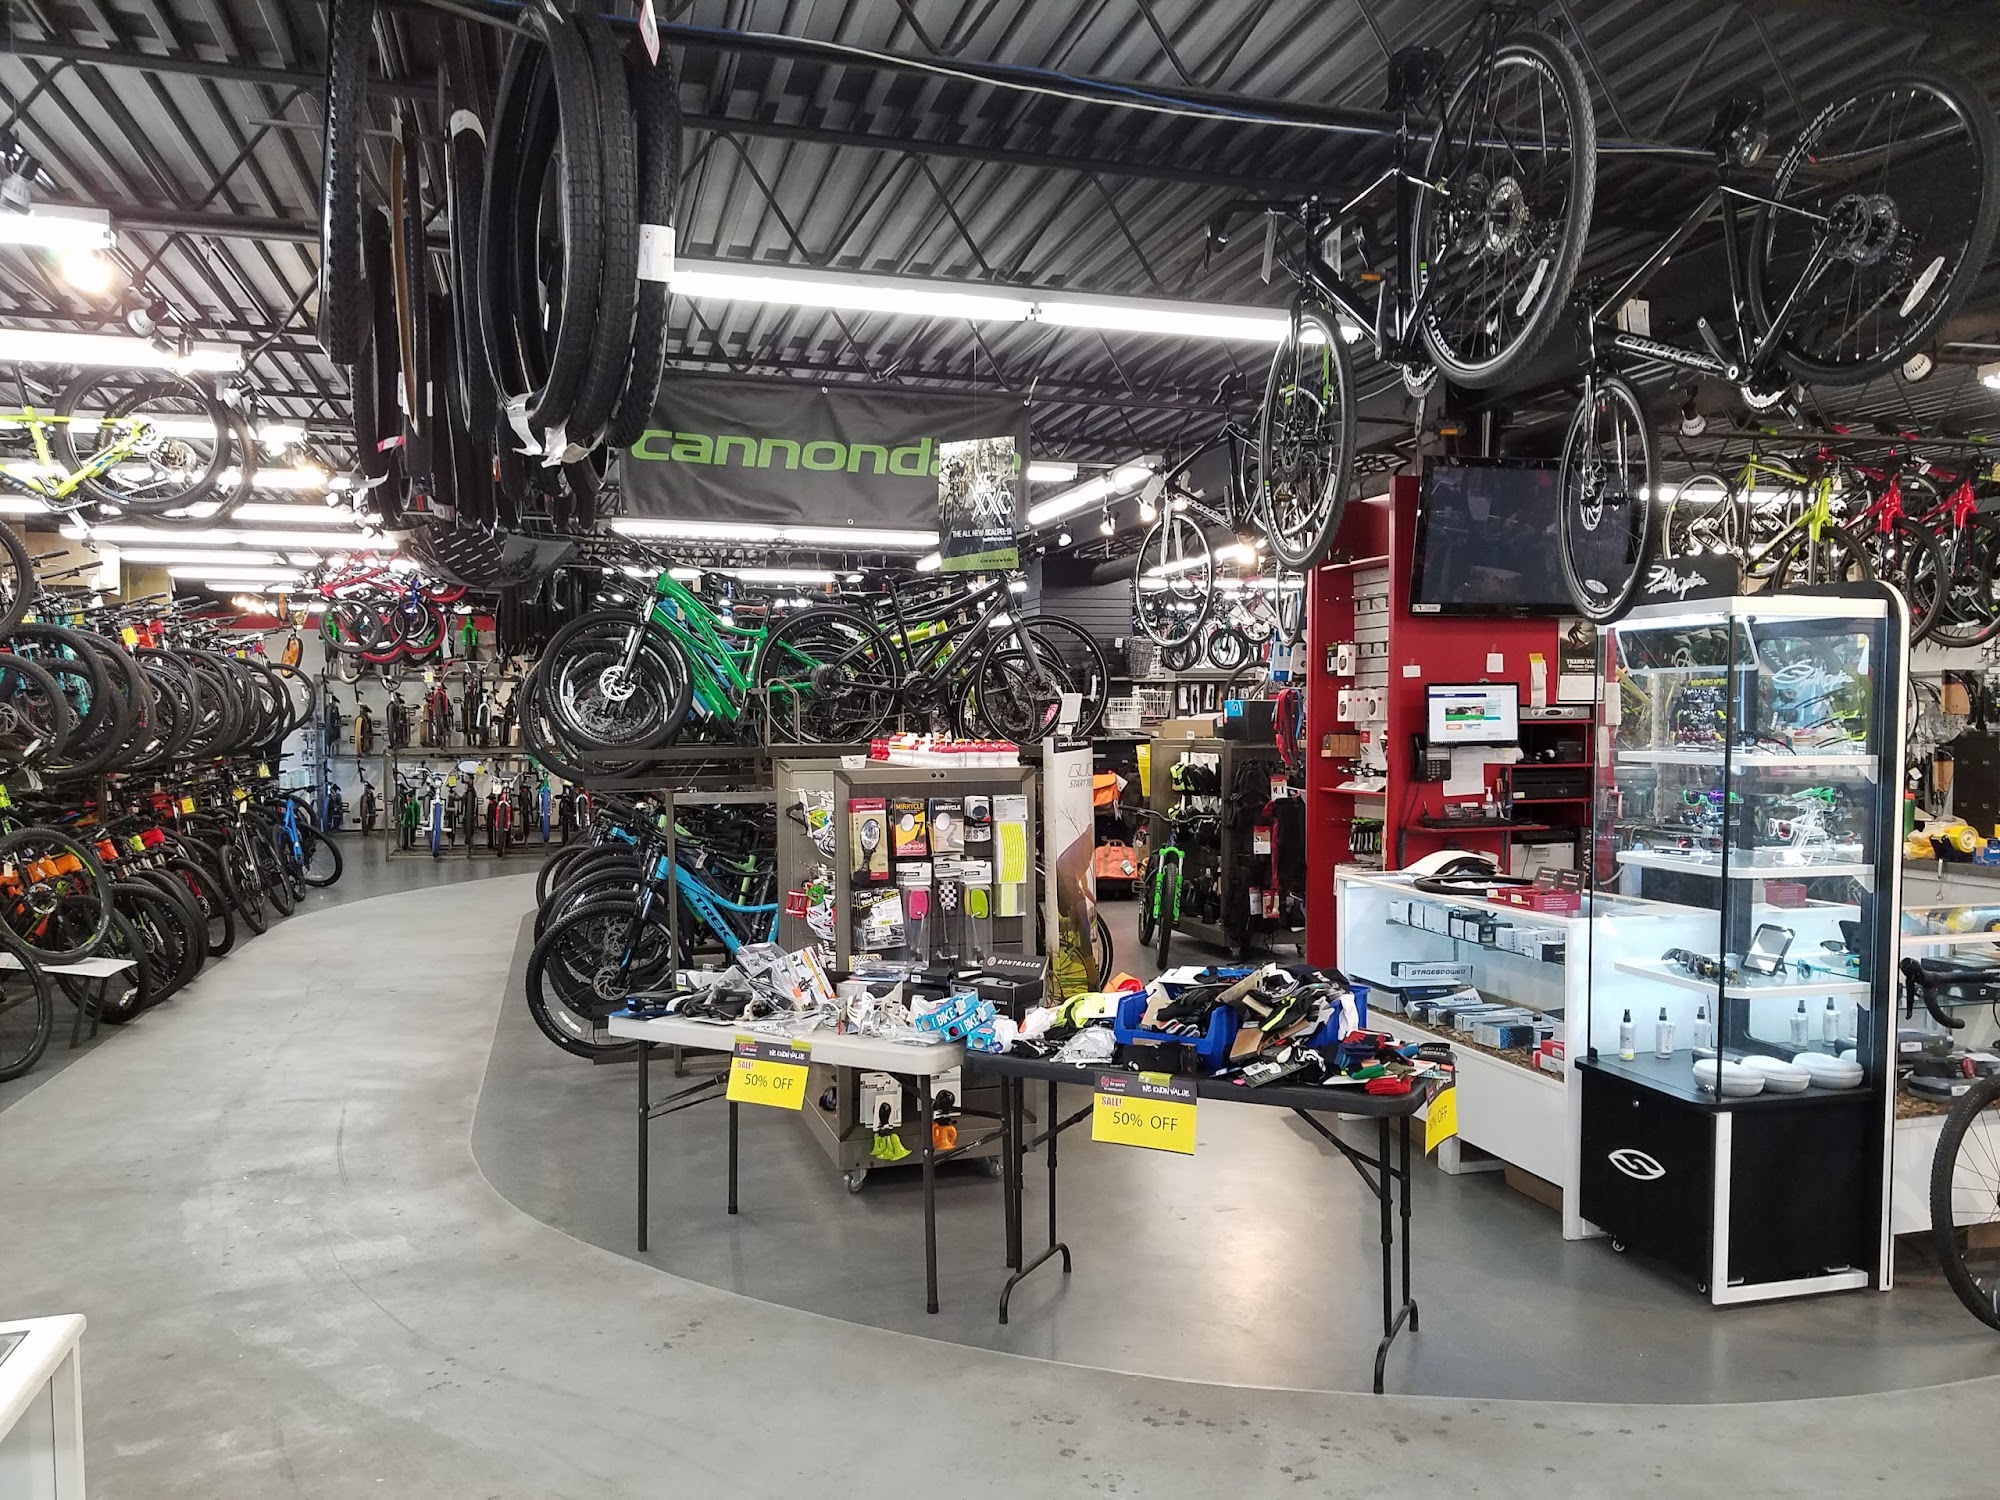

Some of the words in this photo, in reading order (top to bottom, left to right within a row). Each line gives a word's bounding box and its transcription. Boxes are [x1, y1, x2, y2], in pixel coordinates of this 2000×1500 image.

[1614, 333, 1718, 370] cannondale
[631, 429, 1022, 481] cannond
[895, 802, 925, 810] MIRRYCLE
[695, 893, 731, 938] TREK
[997, 959, 1041, 969] BONTRAGER
[936, 1006, 956, 1028] BIKE
[963, 1012, 980, 1032] BIKE
[737, 1060, 754, 1070] SALE!
[744, 1073, 768, 1088] 50%
[772, 1076, 794, 1091] OFF
[1101, 1096, 1122, 1107] SALE!
[1112, 1111, 1143, 1127] 50%
[1150, 1115, 1179, 1131] OFF
